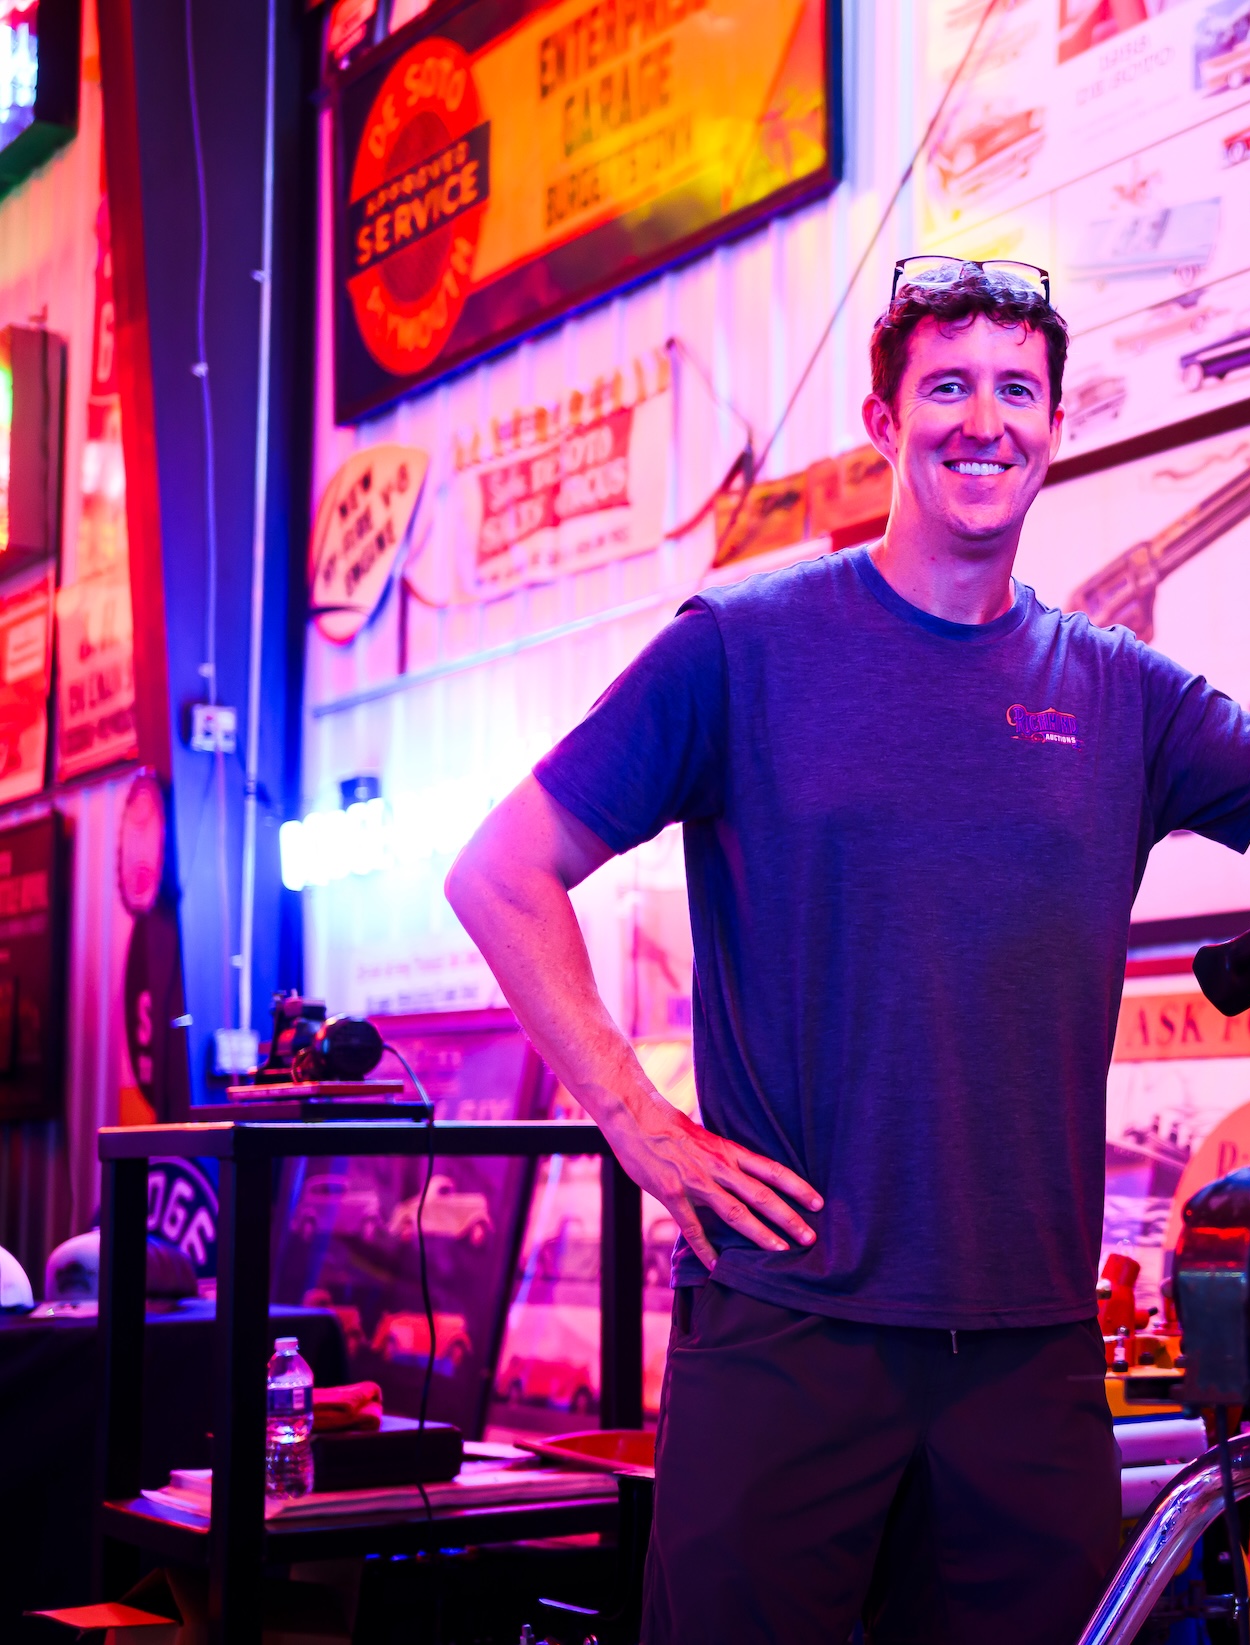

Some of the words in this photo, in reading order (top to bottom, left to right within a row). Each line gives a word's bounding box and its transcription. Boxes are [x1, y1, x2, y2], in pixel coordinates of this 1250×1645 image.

[564, 40, 671, 156] GARAGE
[357, 160, 479, 266] SERVICE
[1045, 733, 1077, 744] AUCTIONS
[1130, 1002, 1203, 1046] ASK
